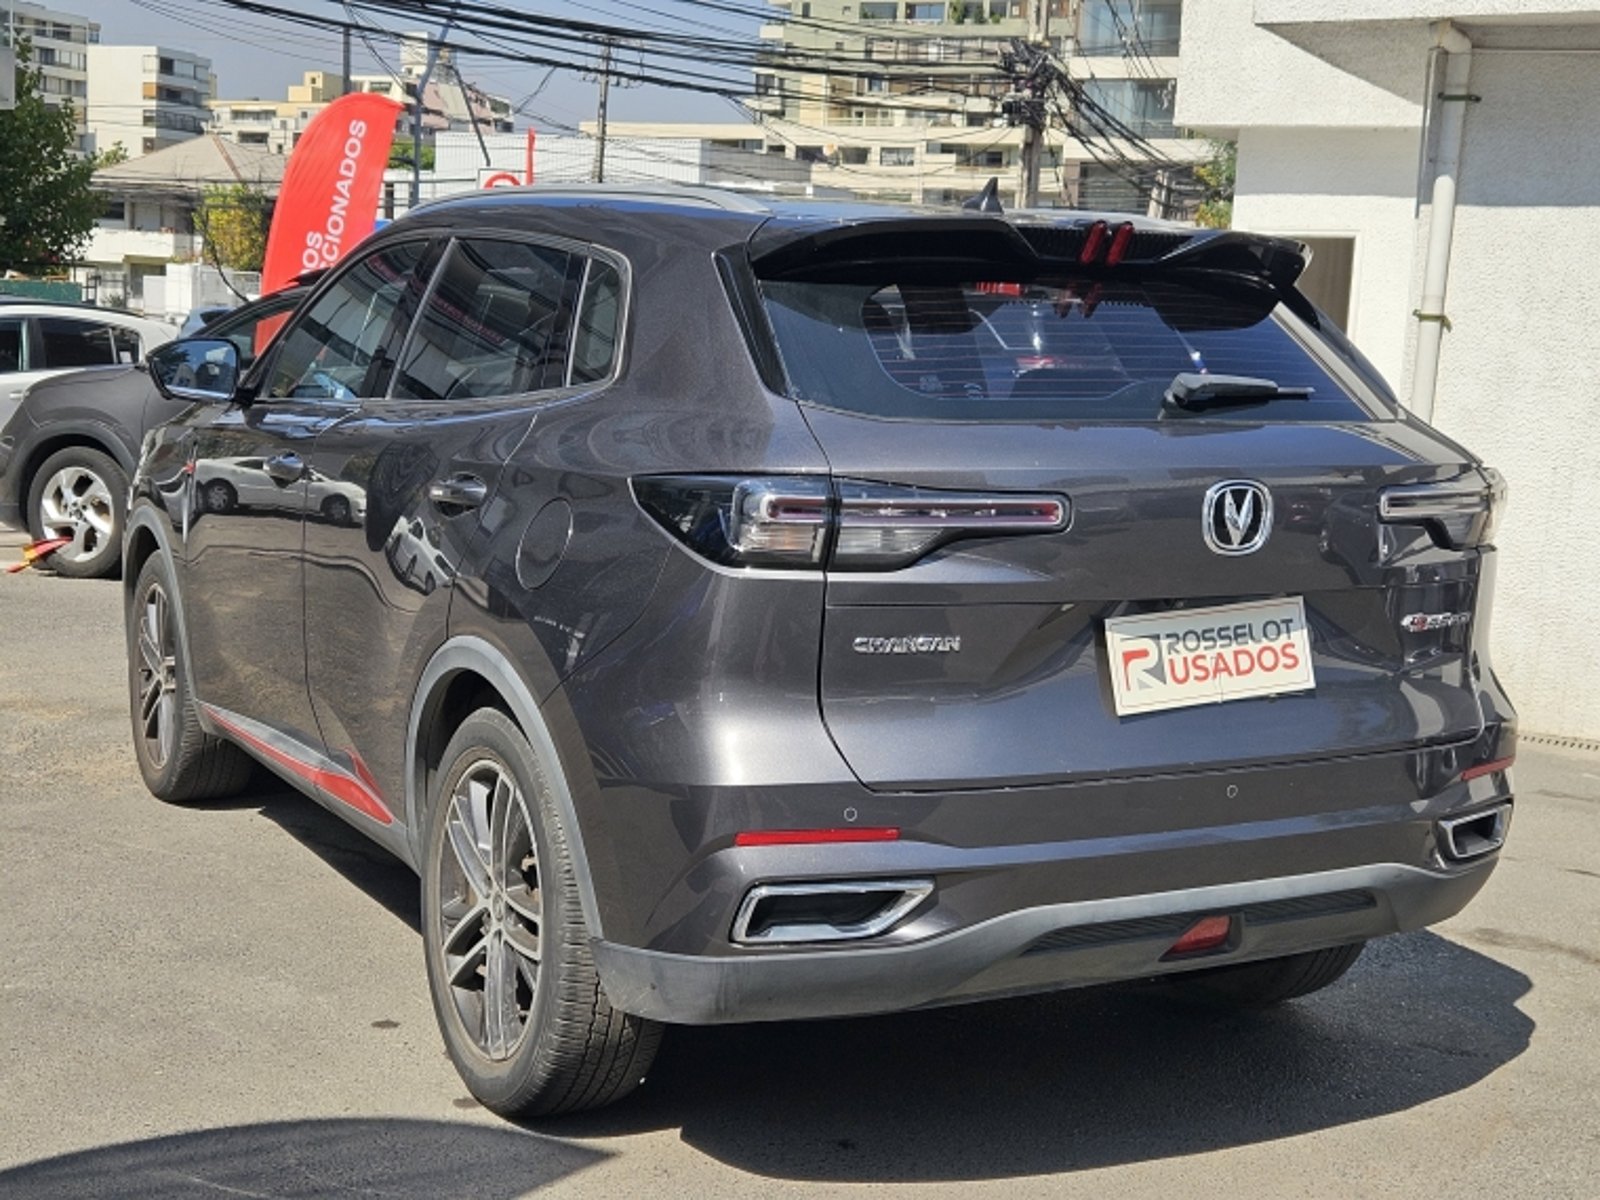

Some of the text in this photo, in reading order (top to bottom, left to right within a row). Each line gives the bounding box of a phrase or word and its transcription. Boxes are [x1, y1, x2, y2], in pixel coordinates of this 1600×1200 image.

[300, 231, 323, 274] OS
[853, 635, 961, 653] CHANGAN
[1165, 618, 1294, 655] ROSSELOT
[1168, 642, 1300, 685] USADOS
